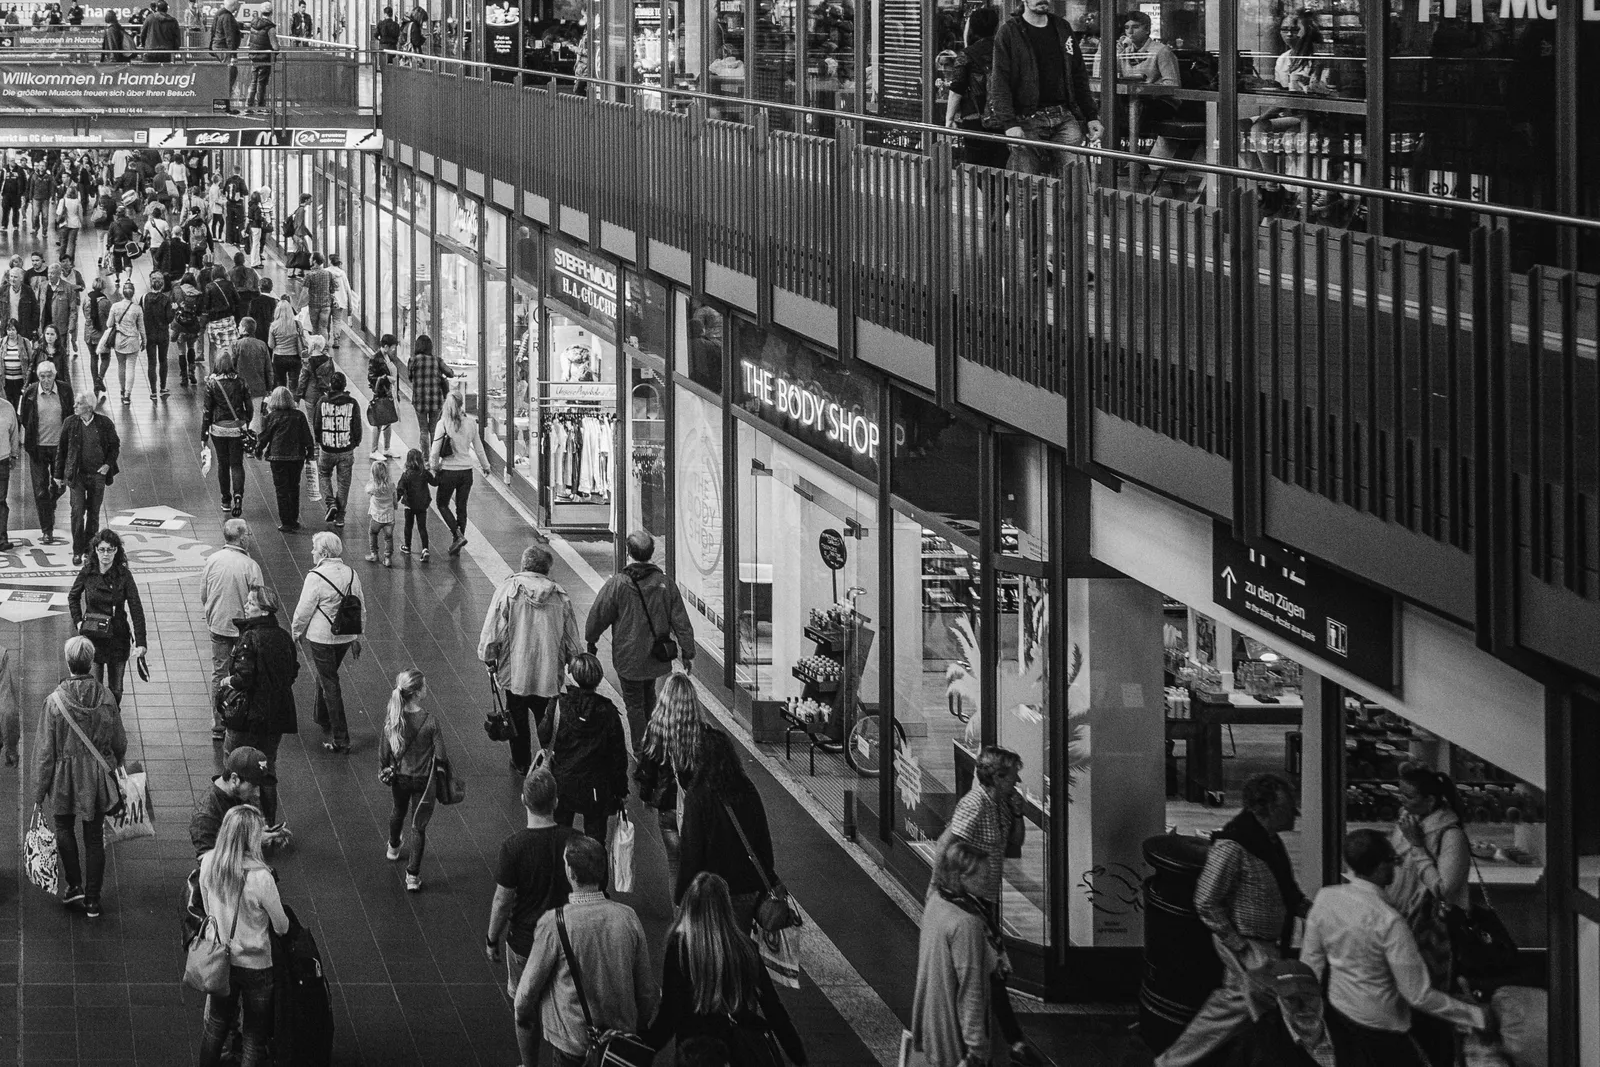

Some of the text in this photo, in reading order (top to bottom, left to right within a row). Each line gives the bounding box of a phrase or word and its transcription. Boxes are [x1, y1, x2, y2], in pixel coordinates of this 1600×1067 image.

[74, 36, 104, 44] Hambu
[2, 72, 196, 88] Willkommen in Hamburg!
[17, 89, 47, 97] größten
[166, 89, 196, 97] Besuch.
[300, 134, 316, 143] 24
[581, 287, 617, 319] GÜLCHE
[741, 360, 879, 458] THE BODY SHOP
[1245, 581, 1305, 620] zu den Zügen
